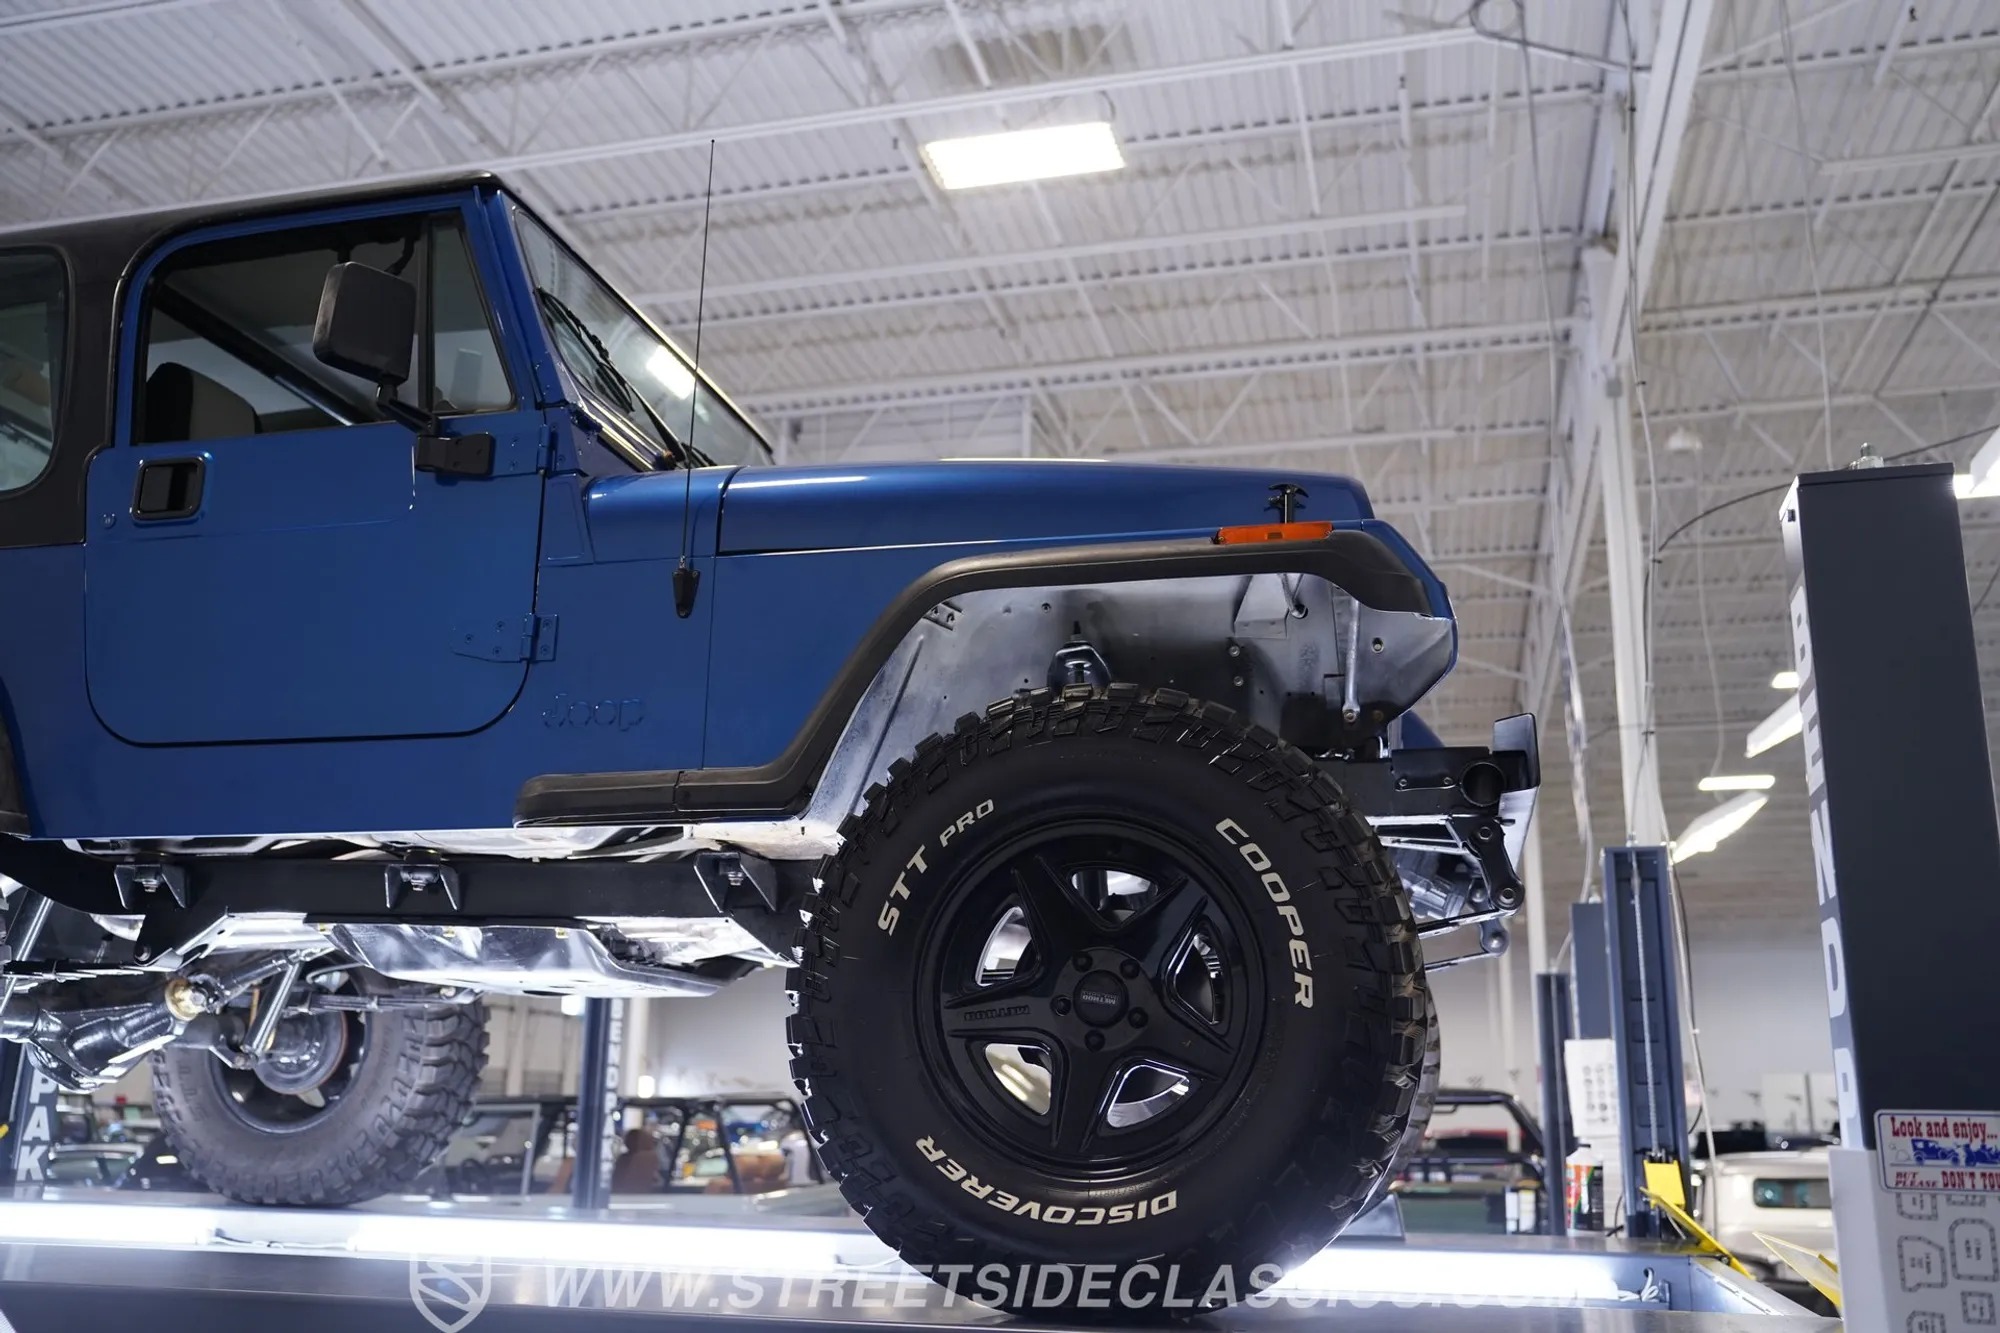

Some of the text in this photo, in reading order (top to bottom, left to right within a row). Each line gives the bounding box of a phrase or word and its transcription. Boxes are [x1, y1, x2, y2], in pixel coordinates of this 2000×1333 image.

[877, 799, 994, 936] STT PRO
[1215, 817, 1314, 1009] COOPER
[963, 1004, 1031, 1022] METHOD
[1890, 1116, 1998, 1144] Look and enjoy...
[915, 1135, 1178, 1225] DISCOVERER
[1941, 1170, 1976, 1189] DON'T
